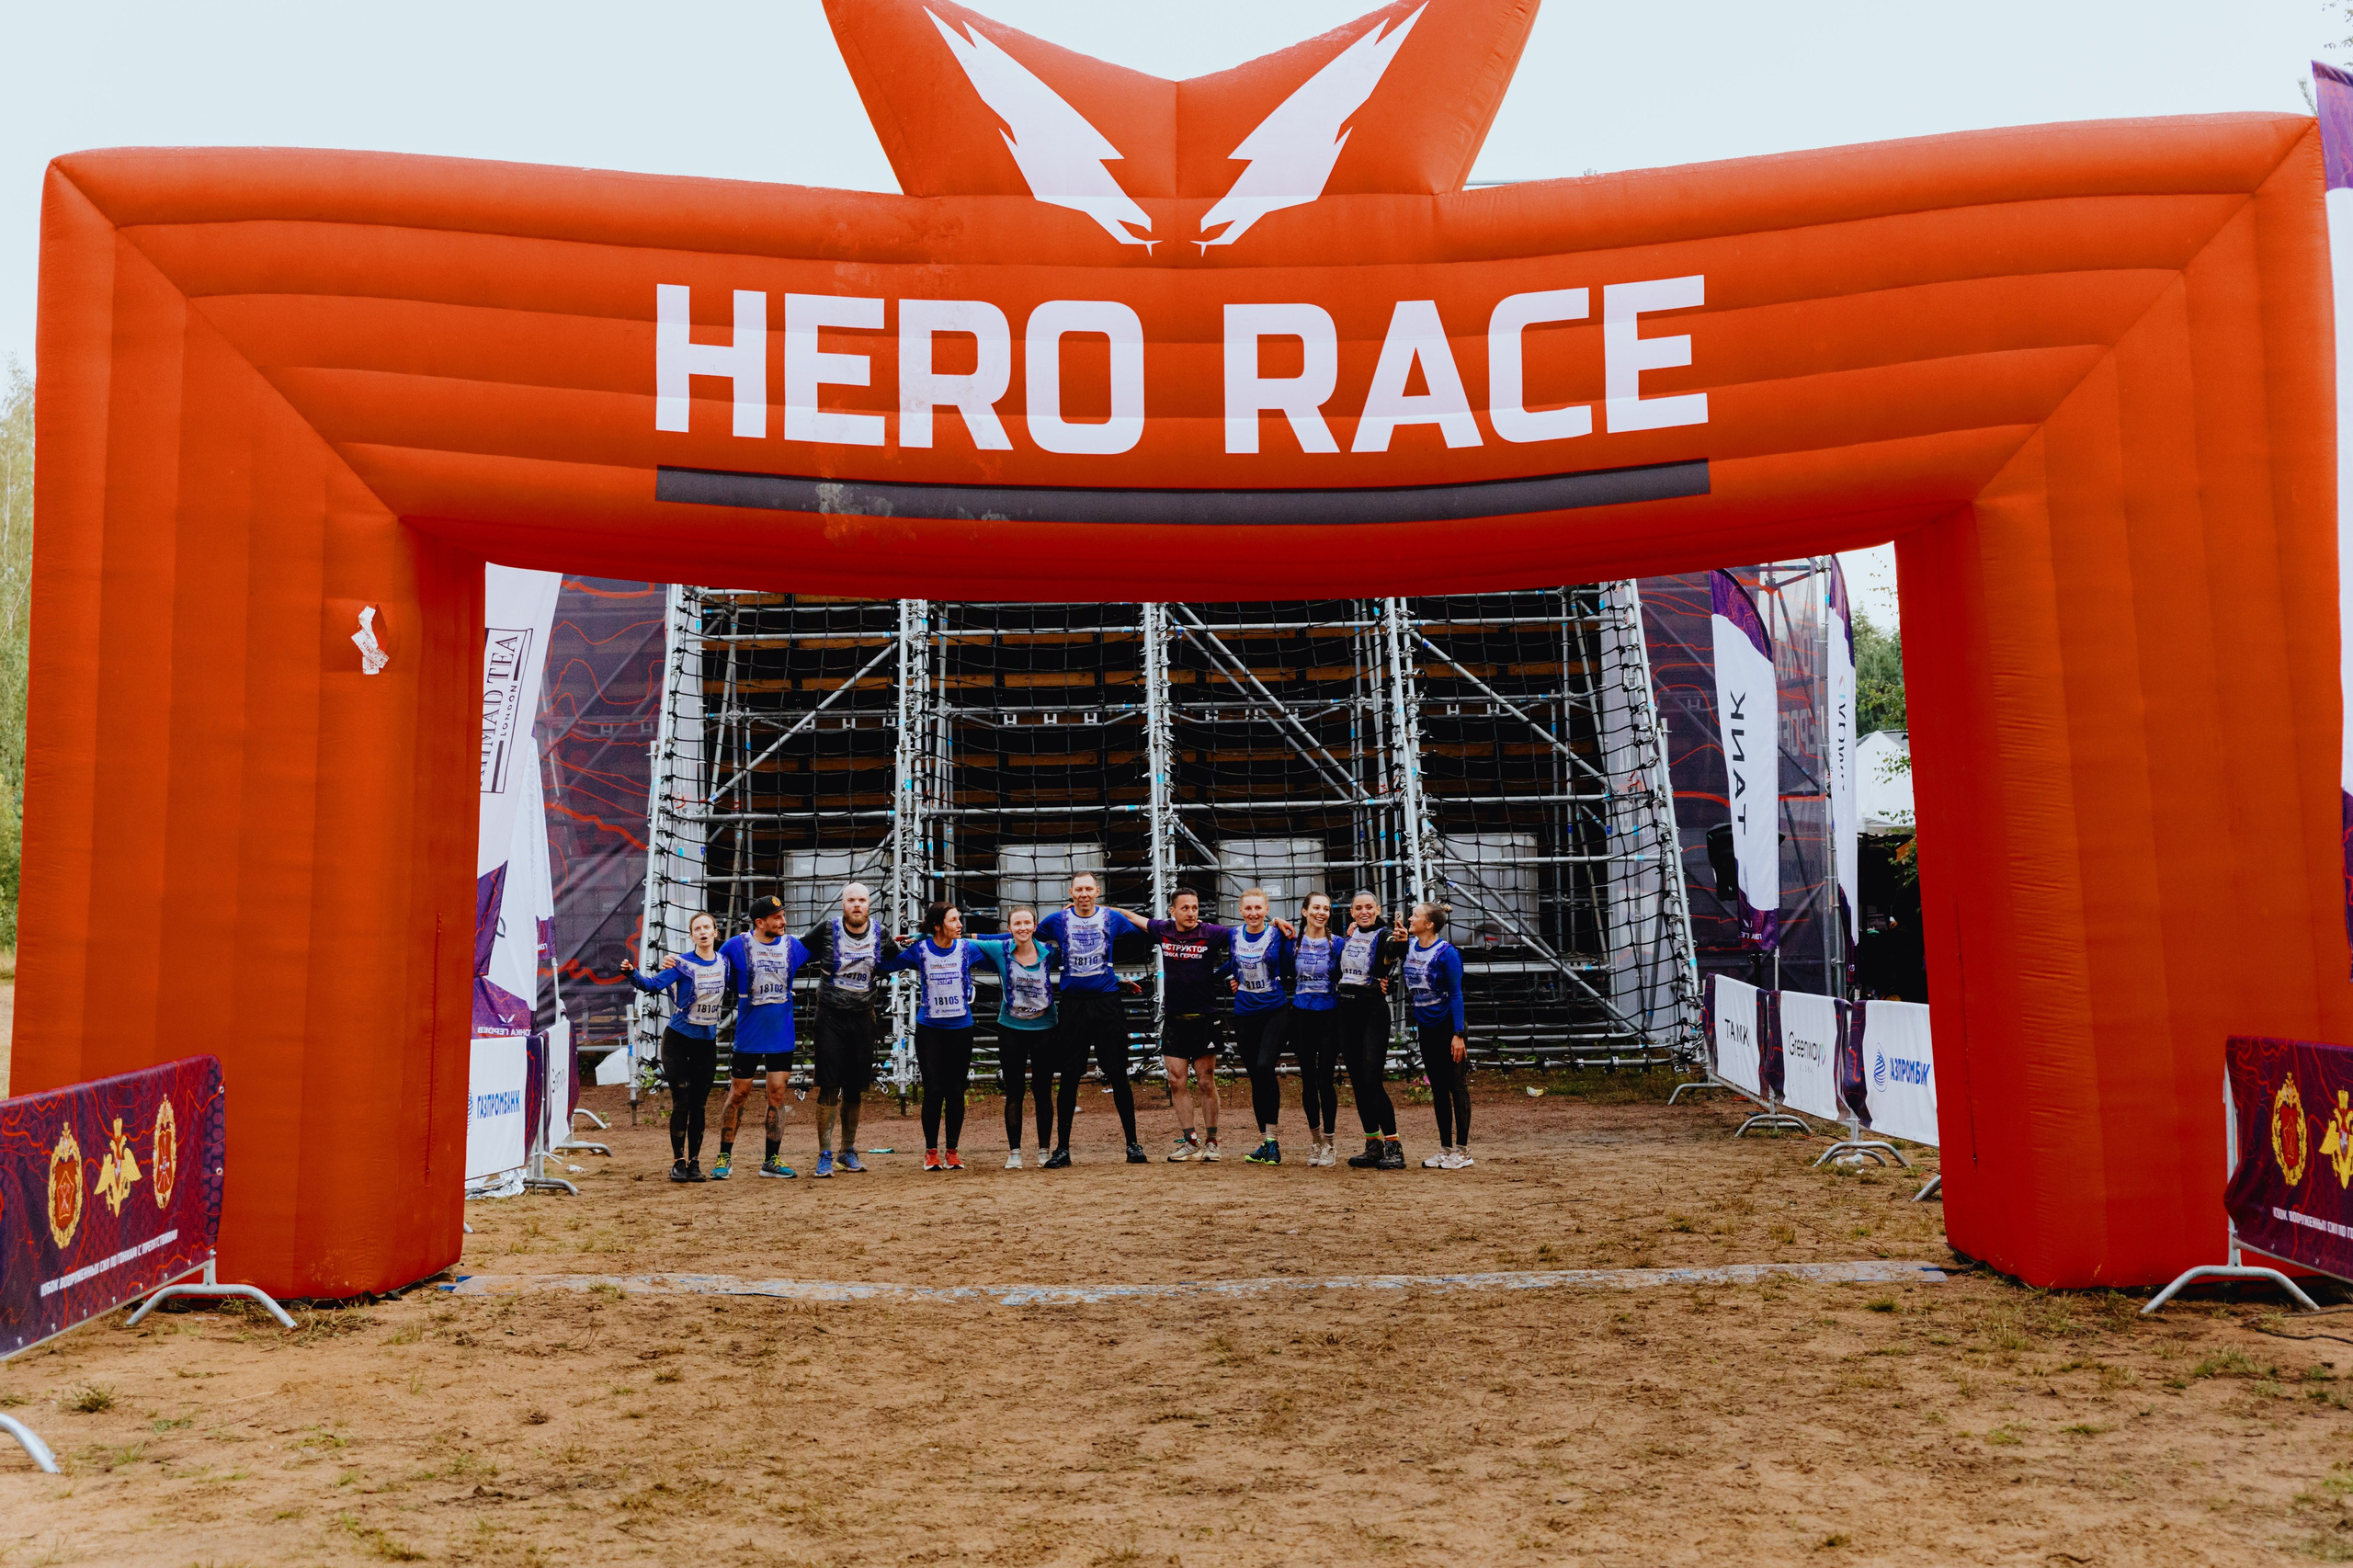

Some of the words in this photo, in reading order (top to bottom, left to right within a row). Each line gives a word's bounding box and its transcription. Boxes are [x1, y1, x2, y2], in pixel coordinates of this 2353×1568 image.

[654, 282, 1145, 455] HERO
[1222, 274, 1710, 455] RACE
[487, 635, 518, 684] TEA
[500, 685, 517, 736] LONDON
[1074, 956, 1098, 965] 18110
[759, 983, 784, 994] 18102
[934, 995, 960, 1006] 18105
[1724, 1018, 1750, 1047] TANK
[1788, 1030, 1822, 1067] Greenway
[477, 1089, 520, 1119] ГАЗПРОМБАНК
[40, 1278, 60, 1298] КУБОК
[60, 1263, 100, 1289] ВООРУЖЕННЫХ
[117, 1246, 138, 1265] ГОНКАМ
[137, 1244, 142, 1256] С
